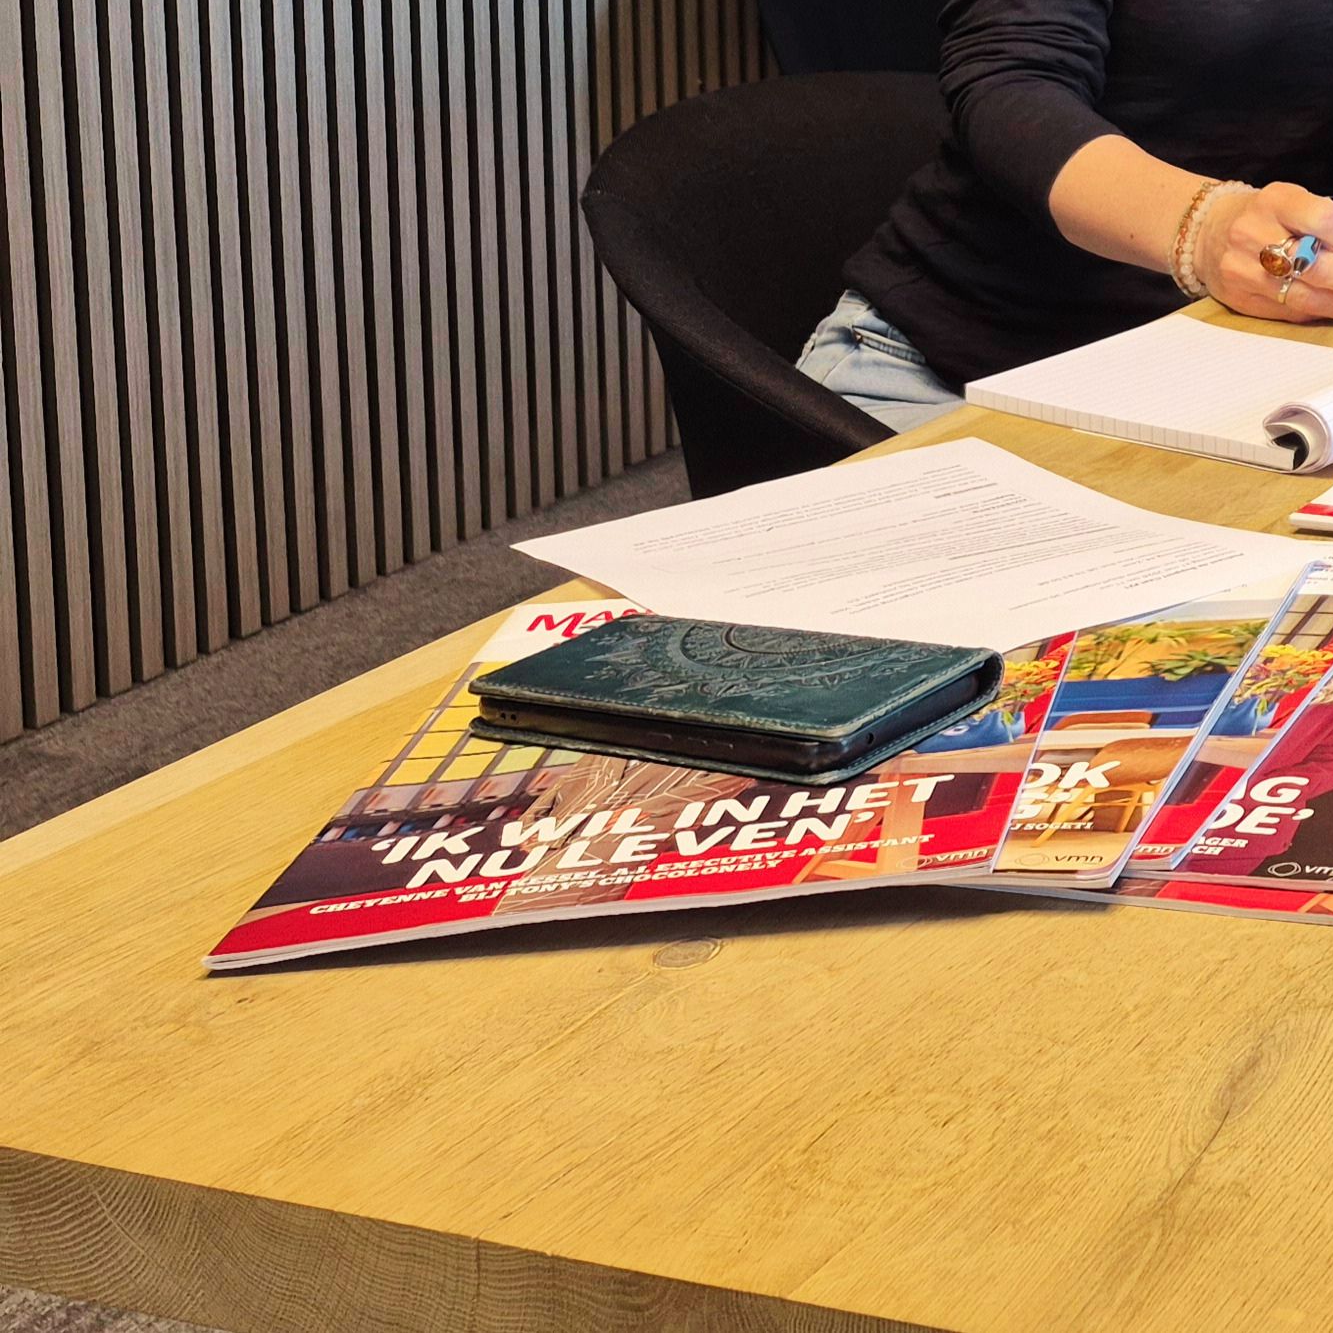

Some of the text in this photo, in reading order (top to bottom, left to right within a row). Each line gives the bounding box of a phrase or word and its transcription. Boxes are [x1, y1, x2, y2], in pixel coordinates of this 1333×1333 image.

[500, 803, 656, 848] WIL
[674, 784, 774, 830] IN
[777, 774, 955, 819] HET
[309, 888, 452, 915] CHEYENNE
[453, 880, 508, 895] VAN
[653, 850, 794, 873] EXECUTIVE
[799, 833, 936, 857] ASSISTANT
[406, 840, 551, 890] NU
[937, 847, 990, 863] vmn
[1053, 854, 1104, 865] vmn
[457, 859, 784, 903] BIJ TONY'S CHOCOLONELY
